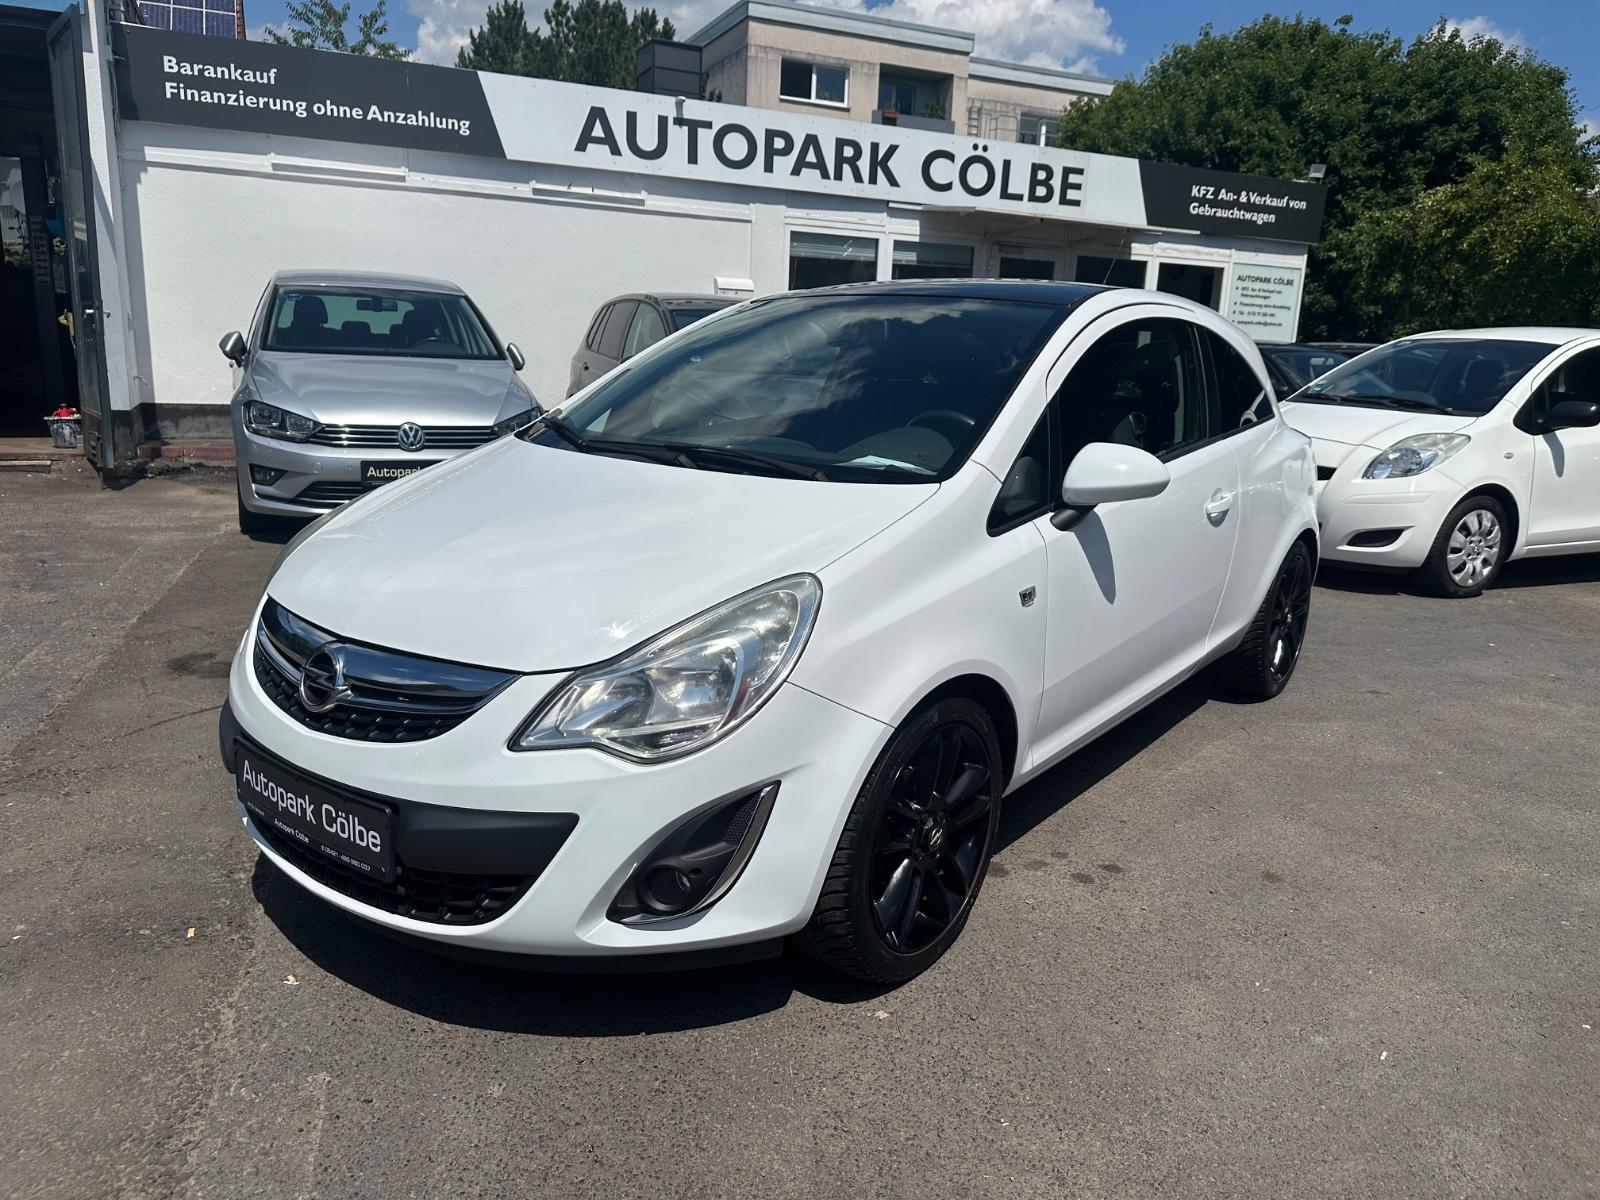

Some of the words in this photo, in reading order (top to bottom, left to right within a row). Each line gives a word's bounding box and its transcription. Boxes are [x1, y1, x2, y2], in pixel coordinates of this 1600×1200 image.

[162, 55, 278, 84] Barankauf
[164, 81, 307, 118] Finanzierung
[312, 100, 364, 121] ohne
[366, 105, 470, 136] Anzahlung
[574, 105, 901, 188] AUTOPARK
[921, 143, 1086, 207] CÖLBE
[1191, 185, 1215, 199] KFZ
[1217, 188, 1238, 202] An-
[1239, 190, 1248, 203] &
[1249, 191, 1289, 208] Verkauf
[1289, 199, 1307, 210] von
[1189, 202, 1276, 225] Gebrauchtwagen
[1237, 275, 1272, 284] AUTOPARK
[243, 759, 317, 825] Autopark
[321, 803, 381, 853] Cölbe
